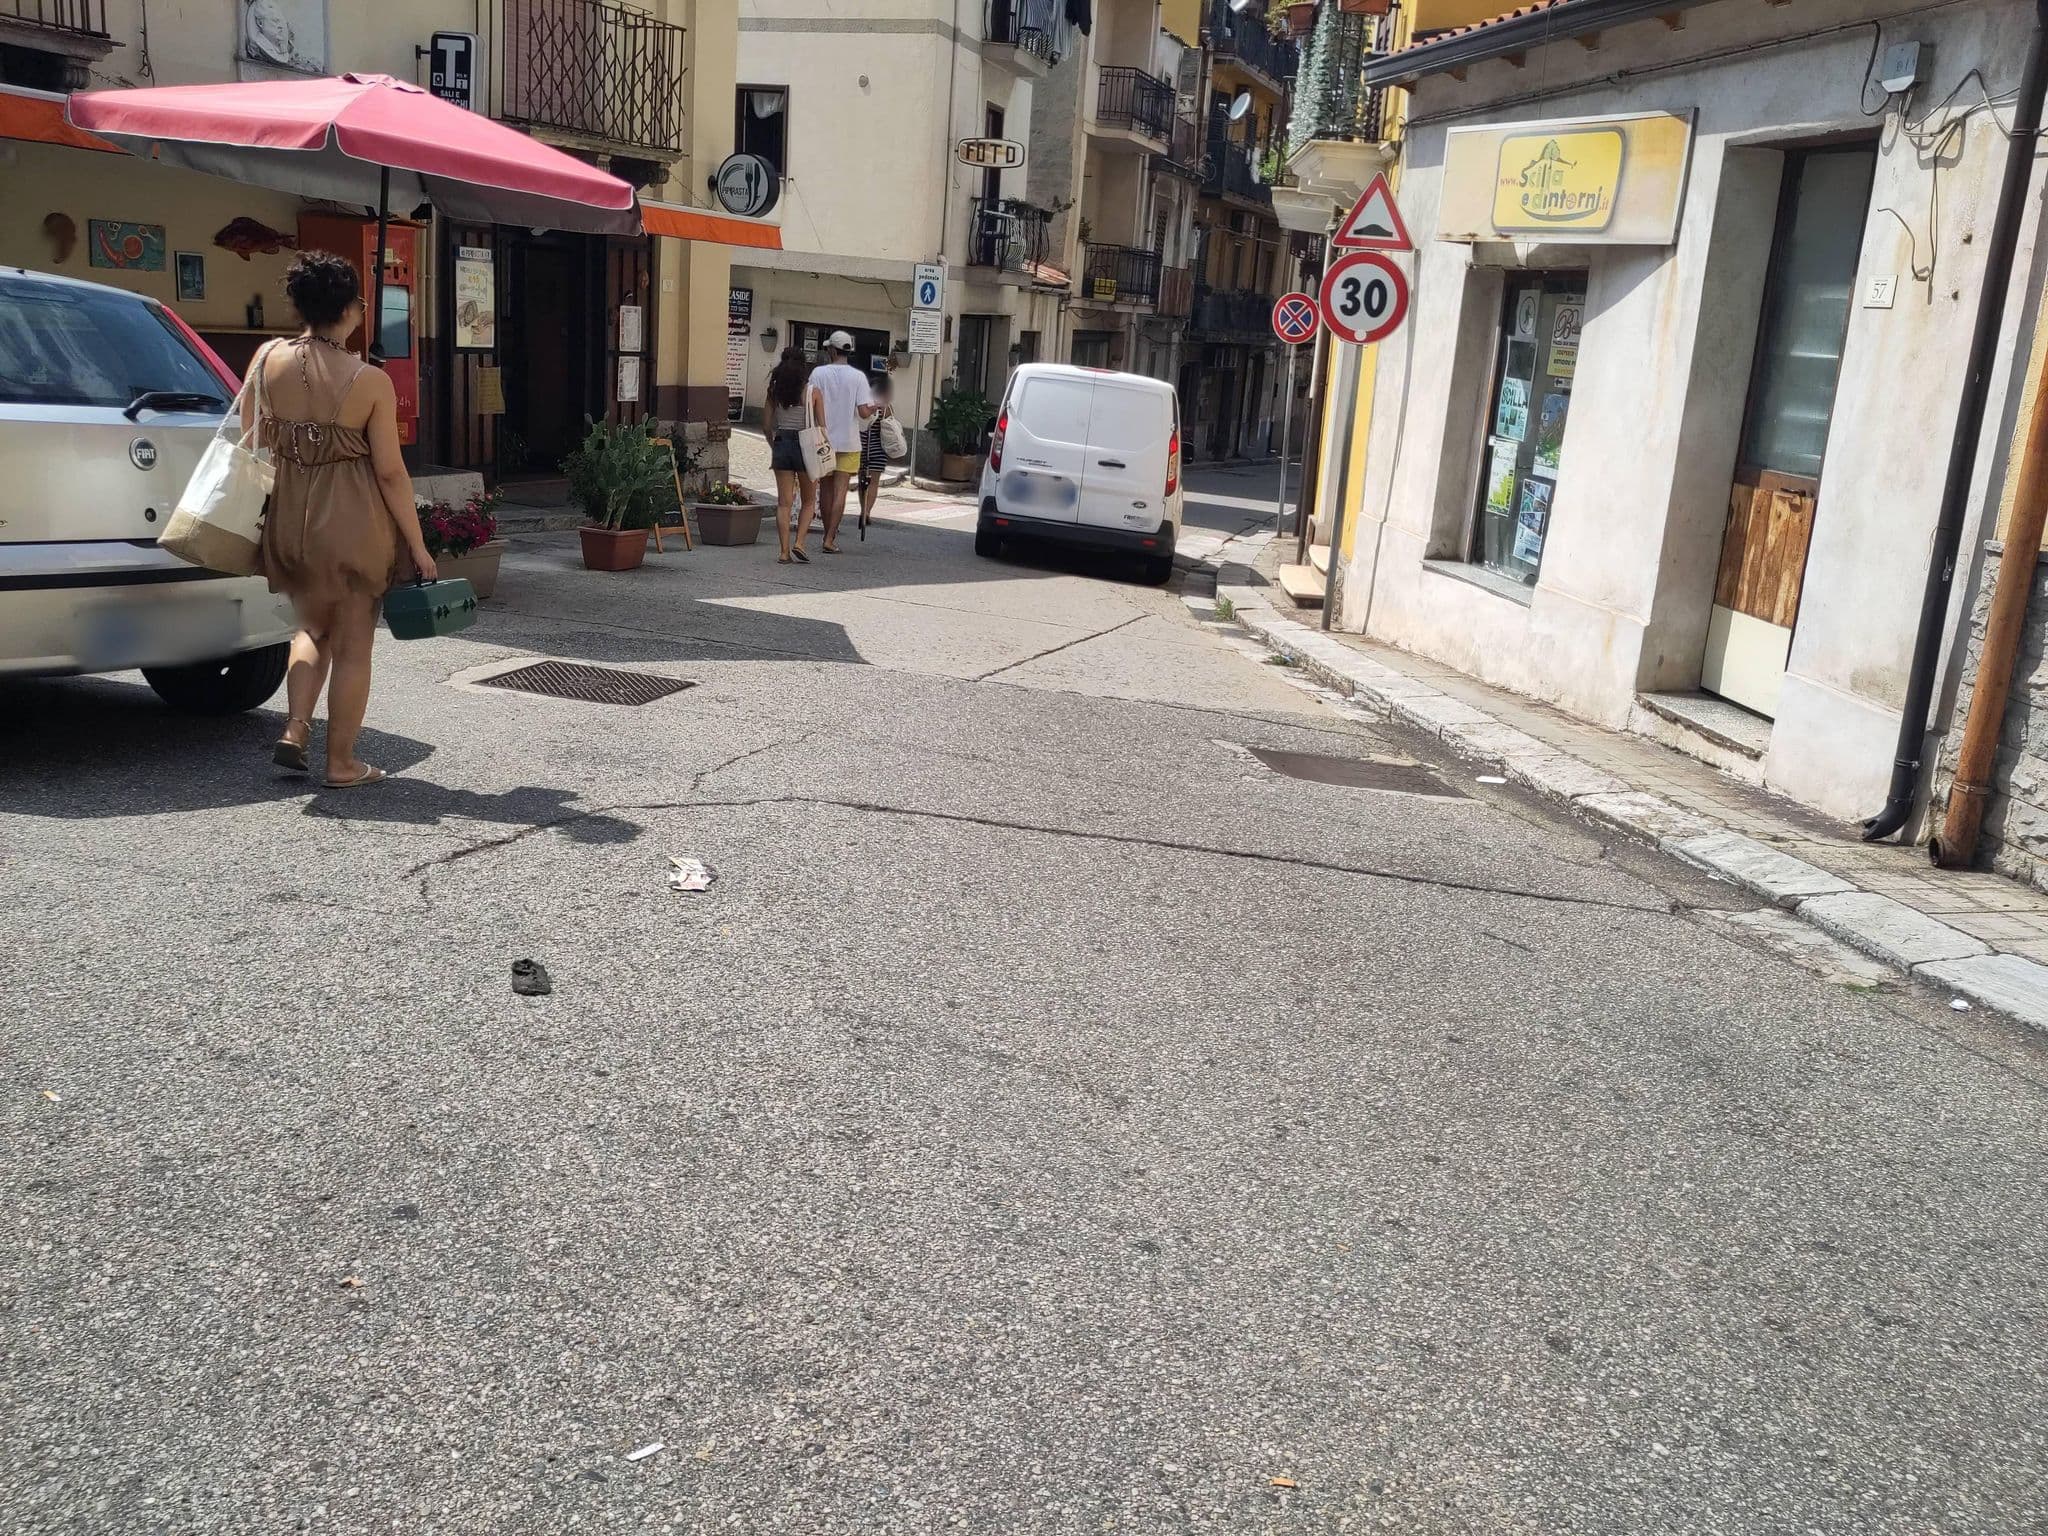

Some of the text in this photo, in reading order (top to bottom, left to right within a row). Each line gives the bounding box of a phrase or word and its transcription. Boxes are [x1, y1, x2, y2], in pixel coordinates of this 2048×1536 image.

[437, 38, 465, 88] T
[440, 90, 455, 98] SALI
[966, 143, 1015, 163] FOTO
[1340, 277, 1387, 318] 30
[1872, 283, 1887, 299] 57
[136, 448, 154, 459] FIAT
